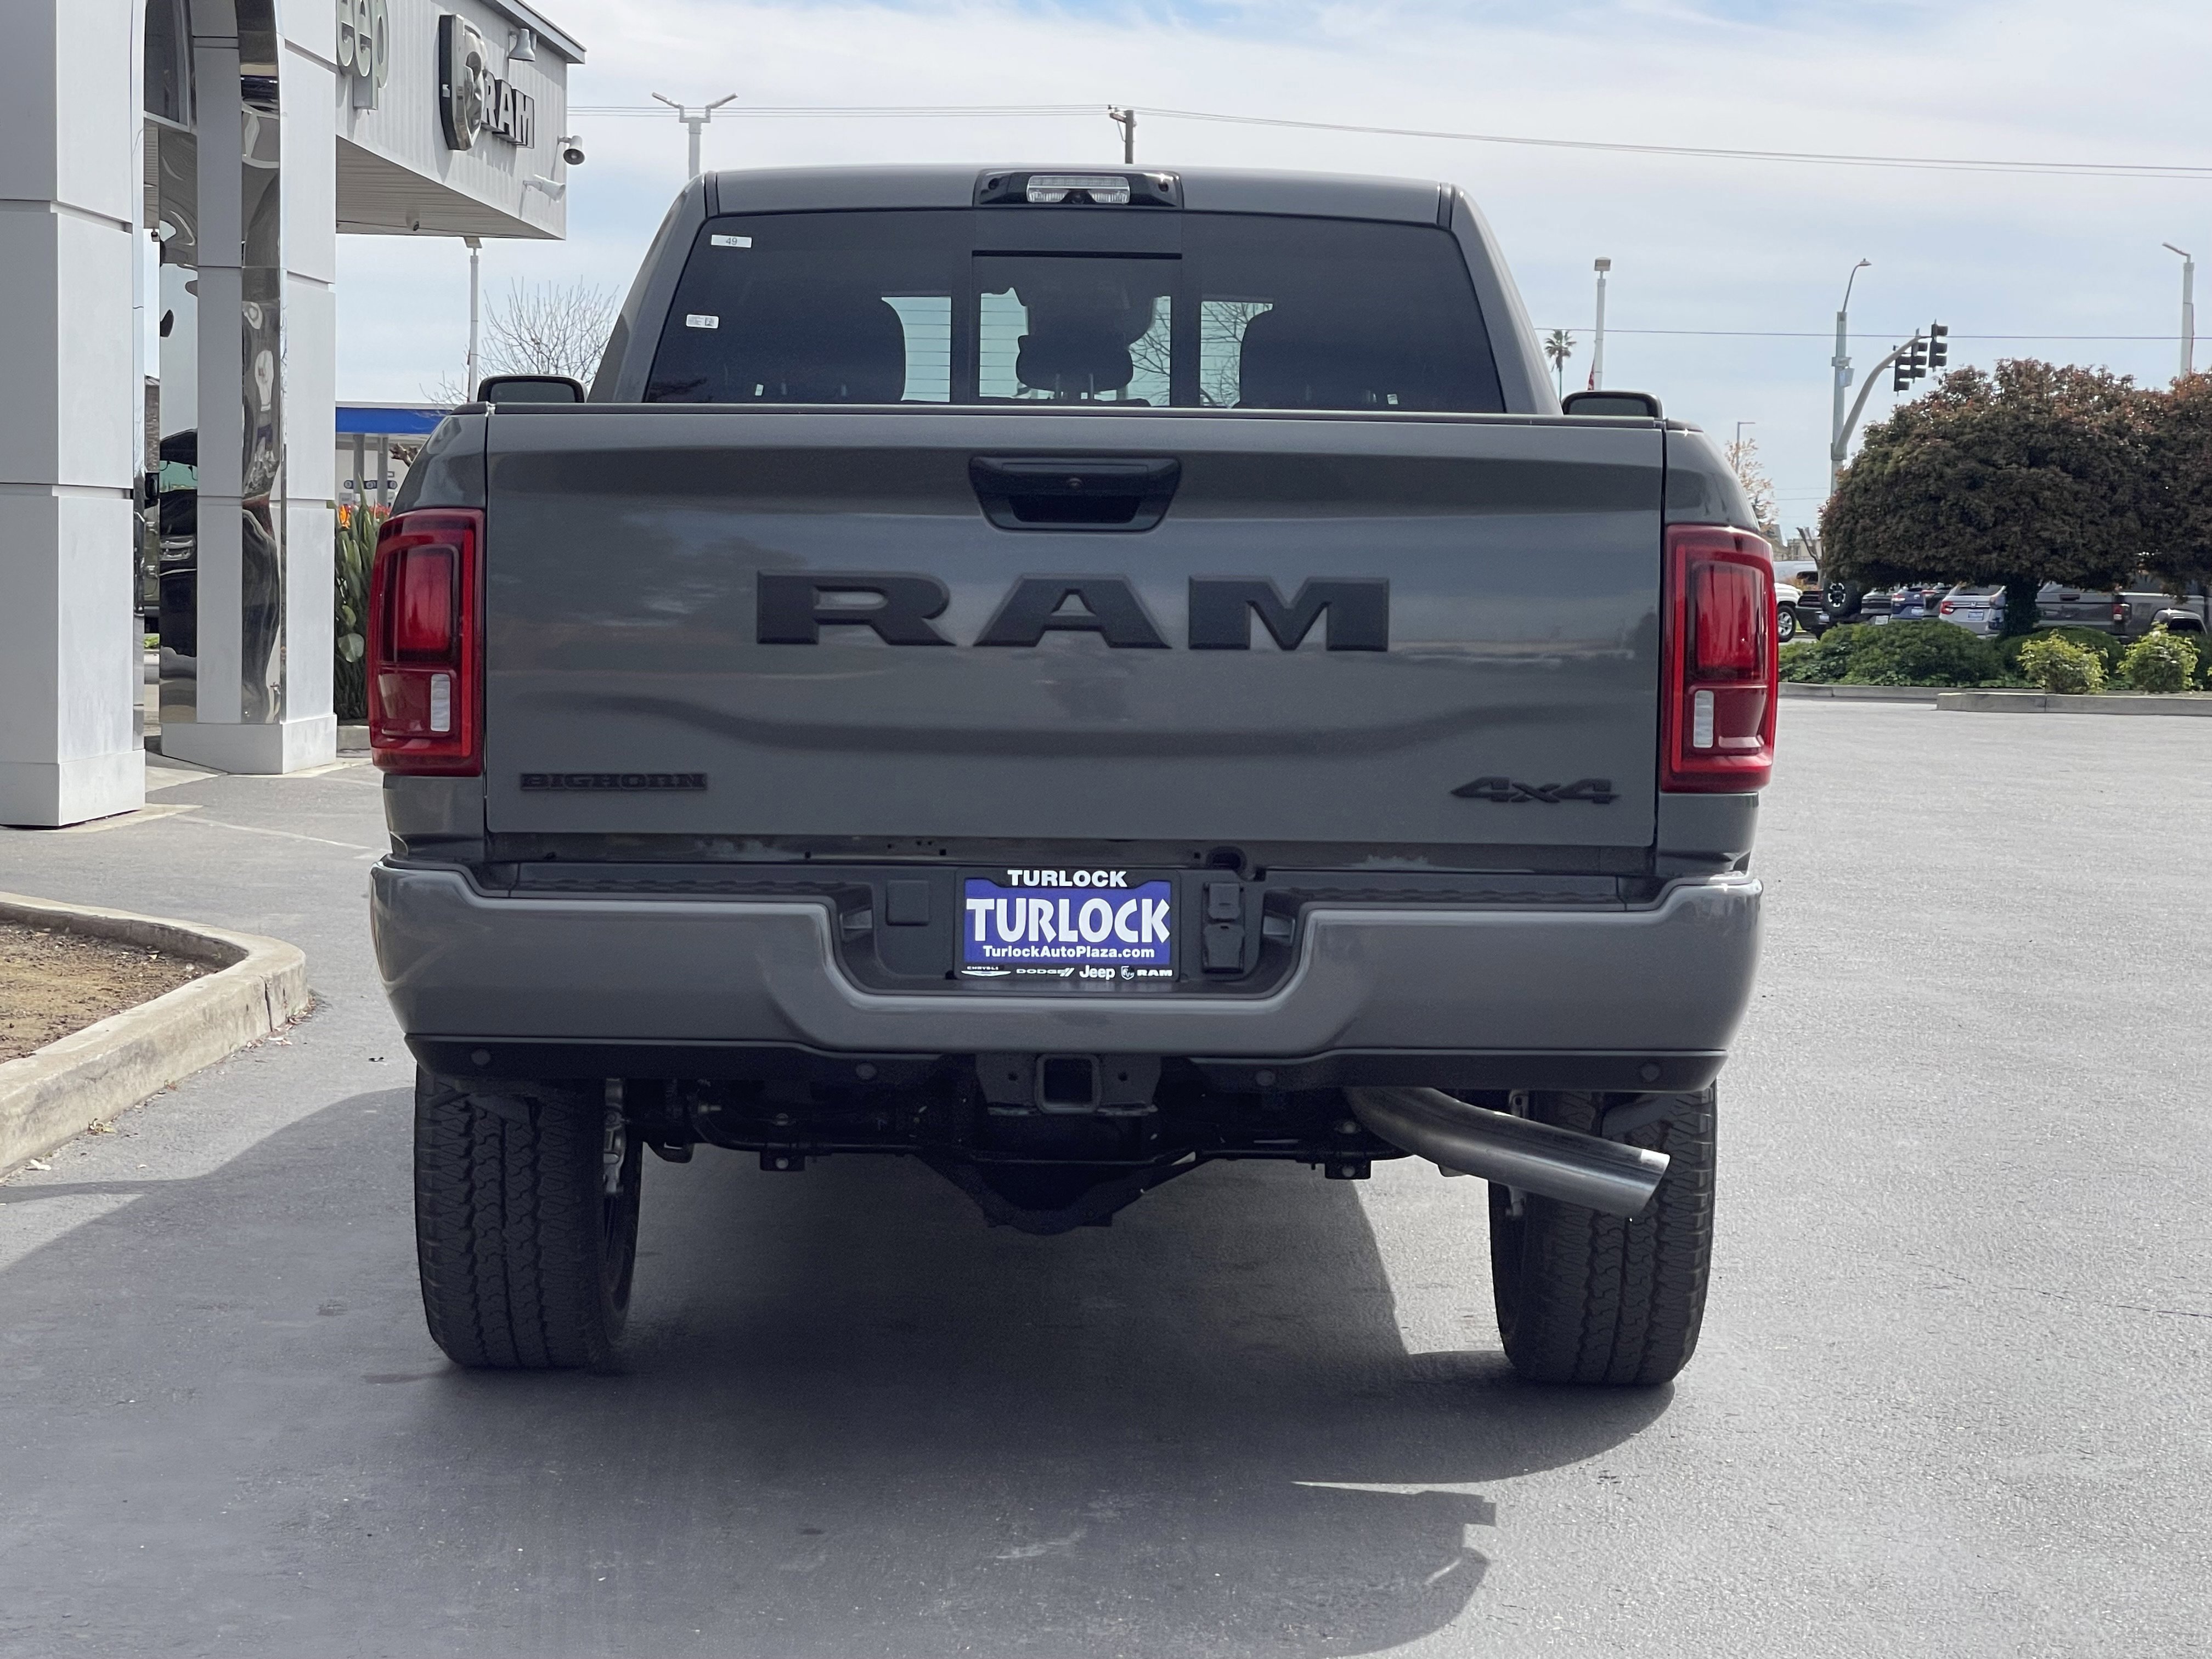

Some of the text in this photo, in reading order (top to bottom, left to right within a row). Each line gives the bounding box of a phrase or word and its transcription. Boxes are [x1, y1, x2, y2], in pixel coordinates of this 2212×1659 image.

[336, 0, 390, 110] eep
[481, 69, 535, 149] RAM
[757, 570, 1389, 651] RAM
[521, 773, 707, 790] BIGHORN
[1451, 777, 1620, 804] 4x4
[1007, 870, 1128, 887] TURLOCK
[966, 898, 1170, 943] TURLOCK
[983, 945, 1155, 958] TurlockAutoPlaza.com
[1079, 964, 1115, 980] Jeep
